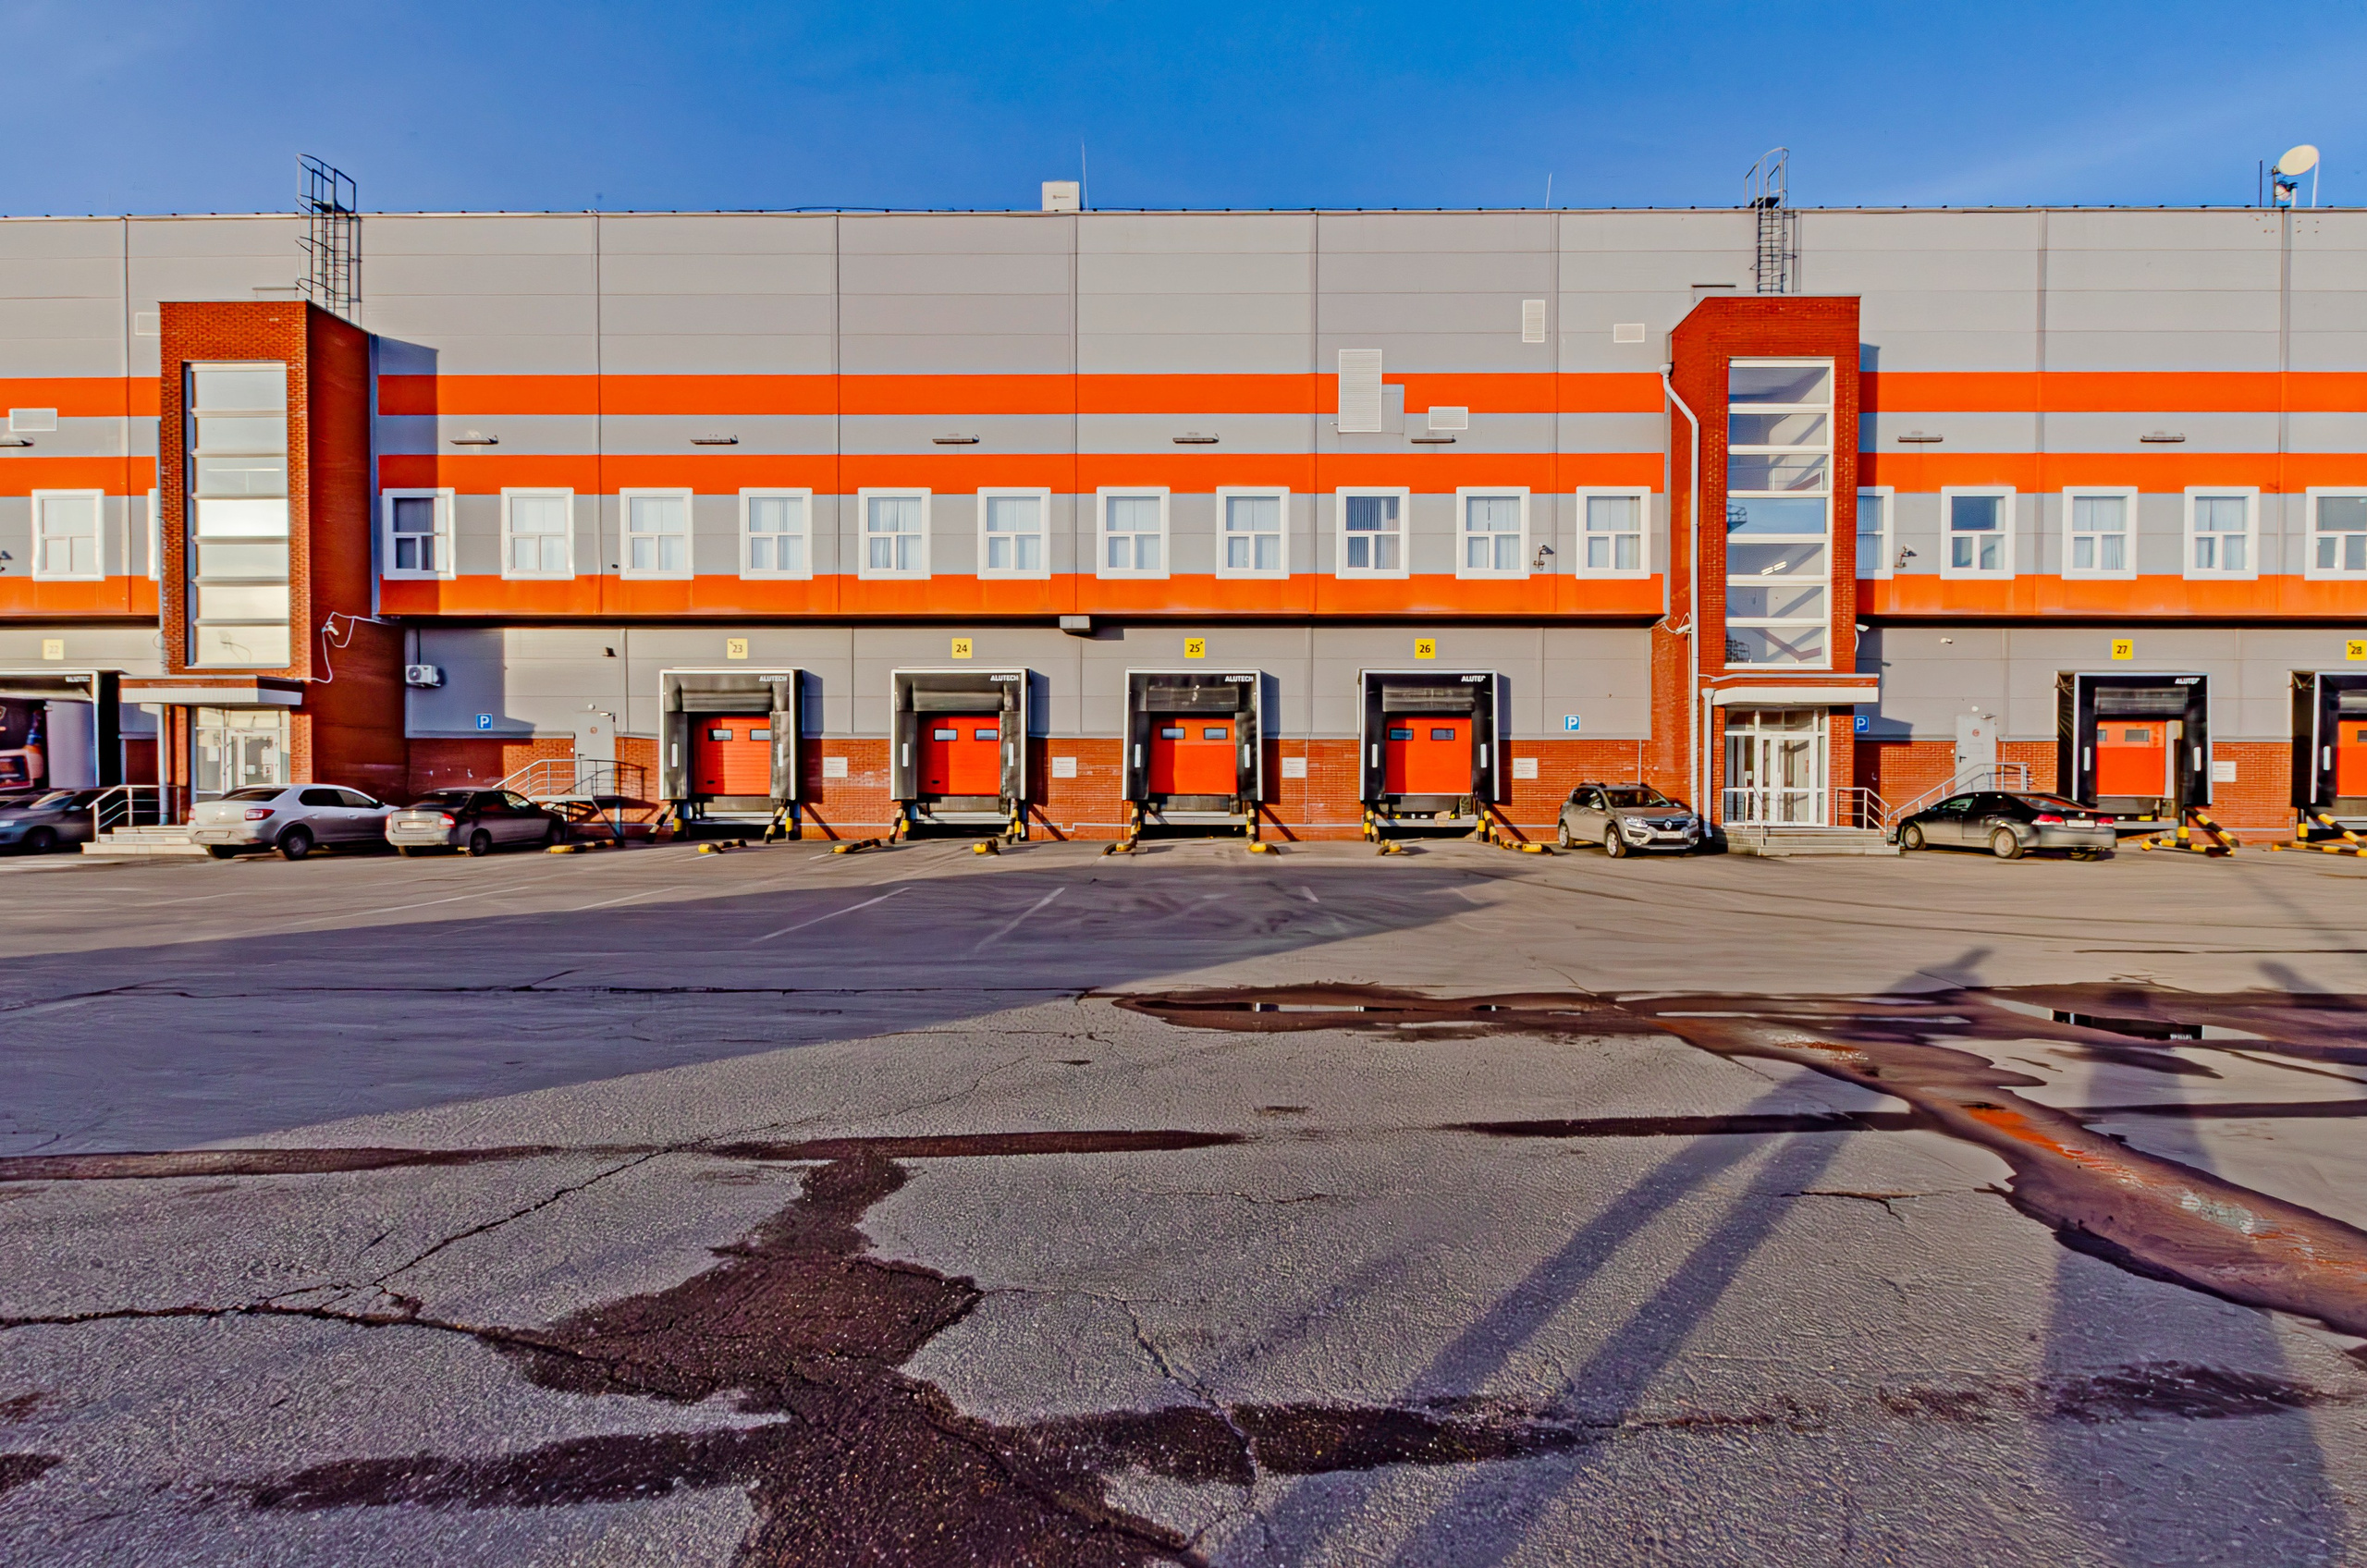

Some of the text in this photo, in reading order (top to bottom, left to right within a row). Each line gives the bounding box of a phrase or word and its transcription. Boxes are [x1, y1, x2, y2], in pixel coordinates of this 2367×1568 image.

[732, 644, 742, 653] 23
[956, 644, 968, 653] 24
[1189, 644, 1200, 653] 25
[1419, 644, 1431, 654] 26
[2116, 645, 2128, 654] 27
[480, 716, 490, 729] P
[1567, 717, 1577, 729] P
[1857, 717, 1866, 729] P
